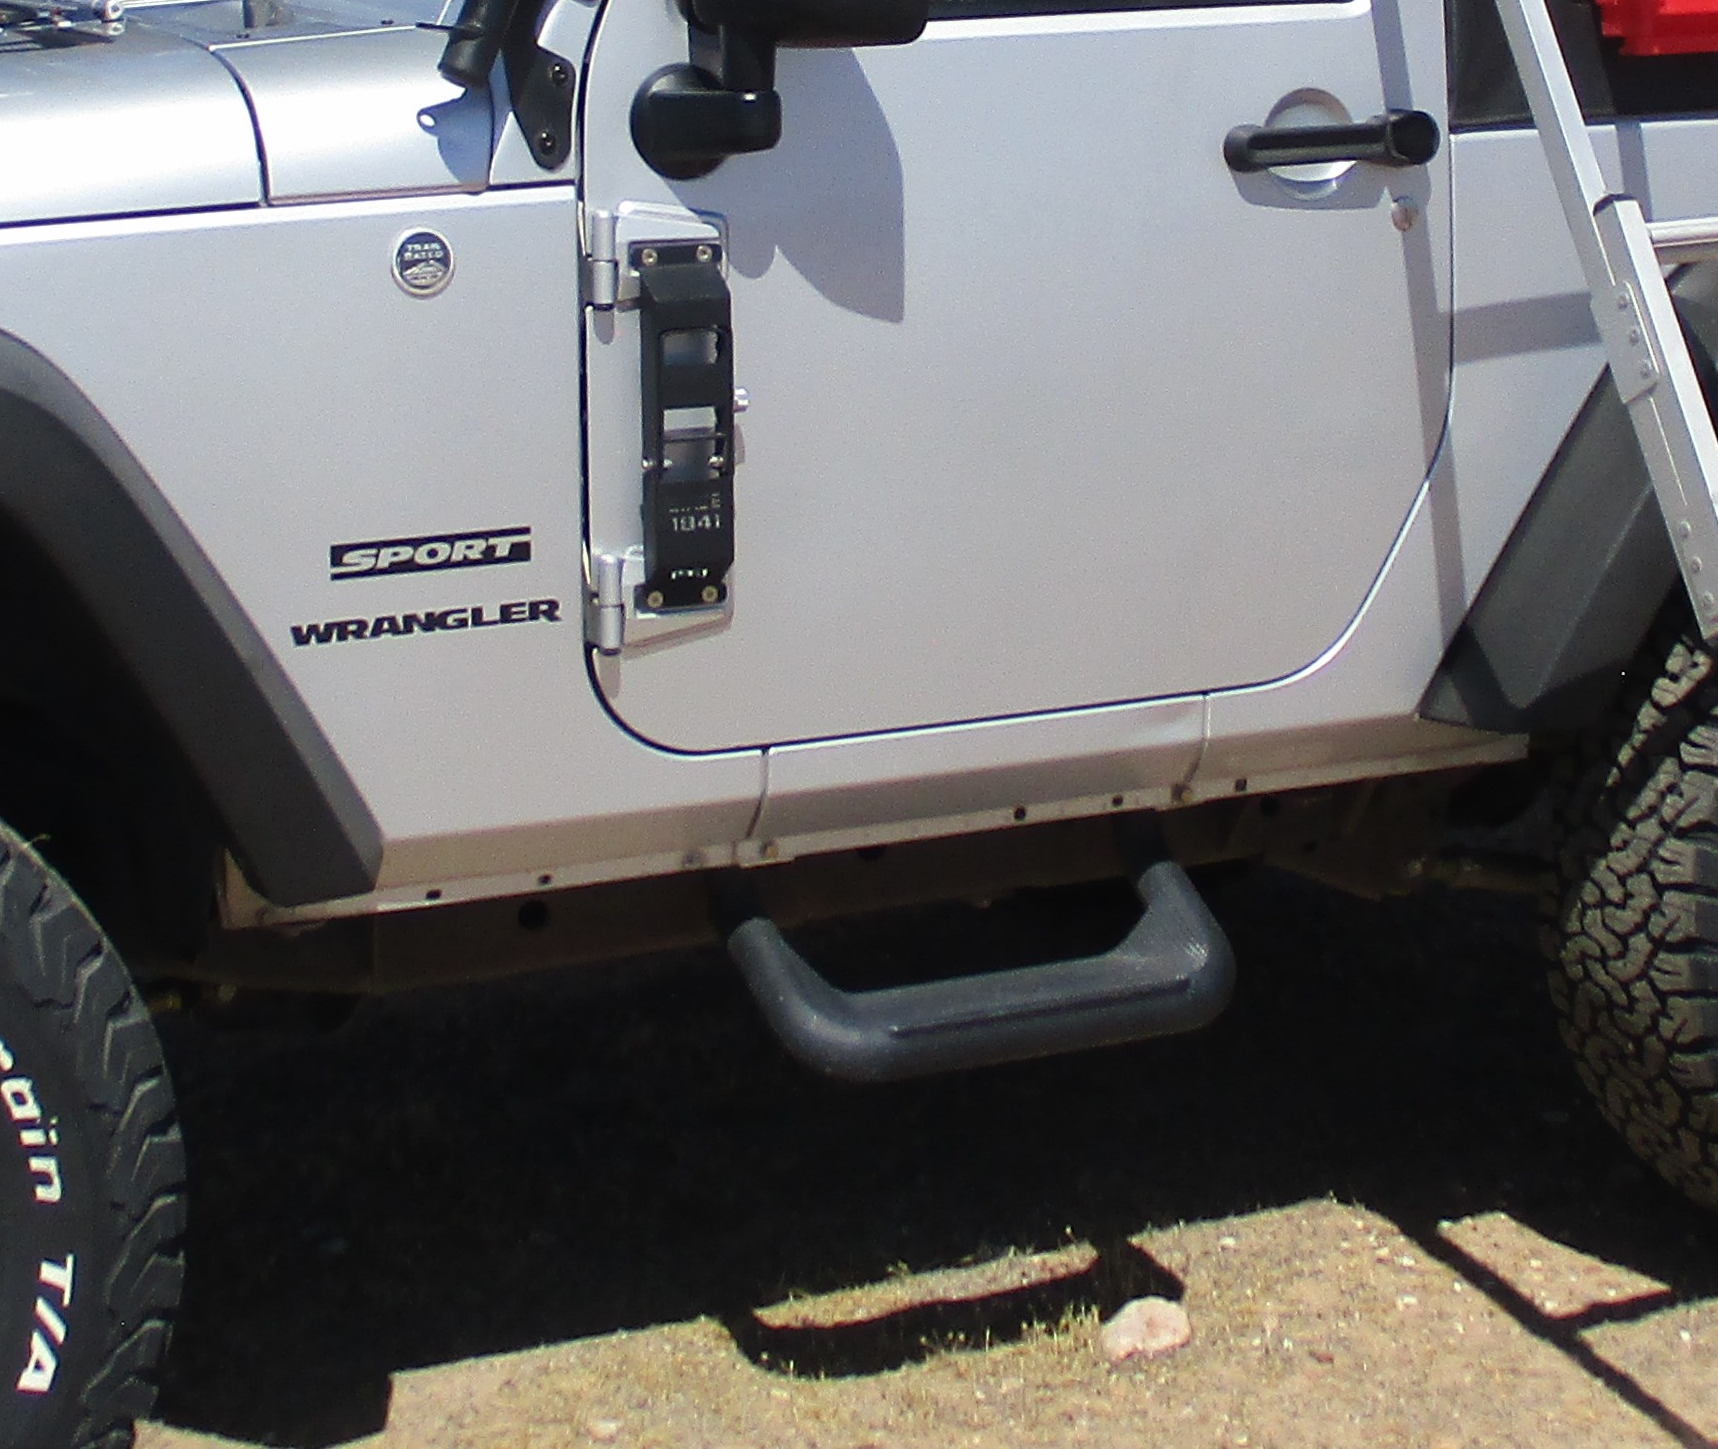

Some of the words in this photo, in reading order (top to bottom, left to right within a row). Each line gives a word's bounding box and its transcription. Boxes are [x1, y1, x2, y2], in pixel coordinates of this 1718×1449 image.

[331, 535, 531, 573] SPORT
[291, 598, 562, 646] WRANGLER
[16, 1253, 74, 1393] T/A
